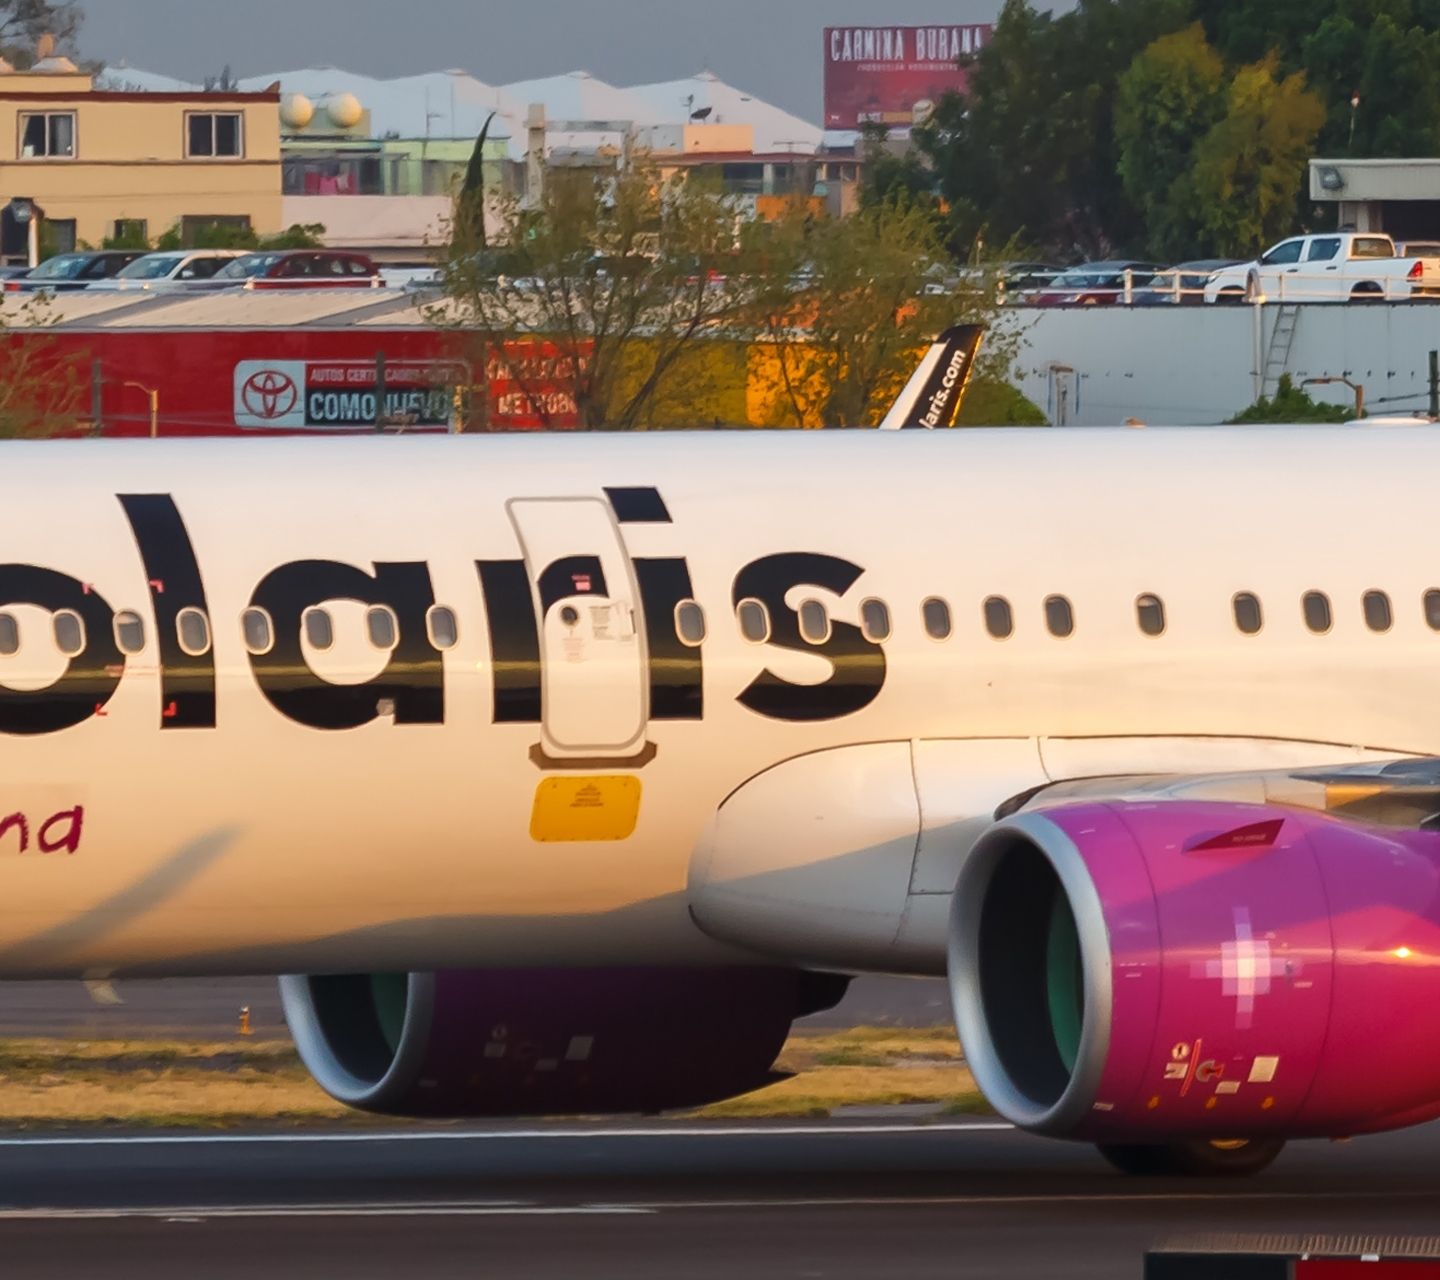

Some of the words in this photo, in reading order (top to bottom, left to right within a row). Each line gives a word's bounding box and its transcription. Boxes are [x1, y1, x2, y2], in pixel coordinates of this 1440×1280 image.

[831, 28, 904, 61] CARMINA
[310, 369, 344, 382] AUTOS
[310, 393, 376, 420] COMO
